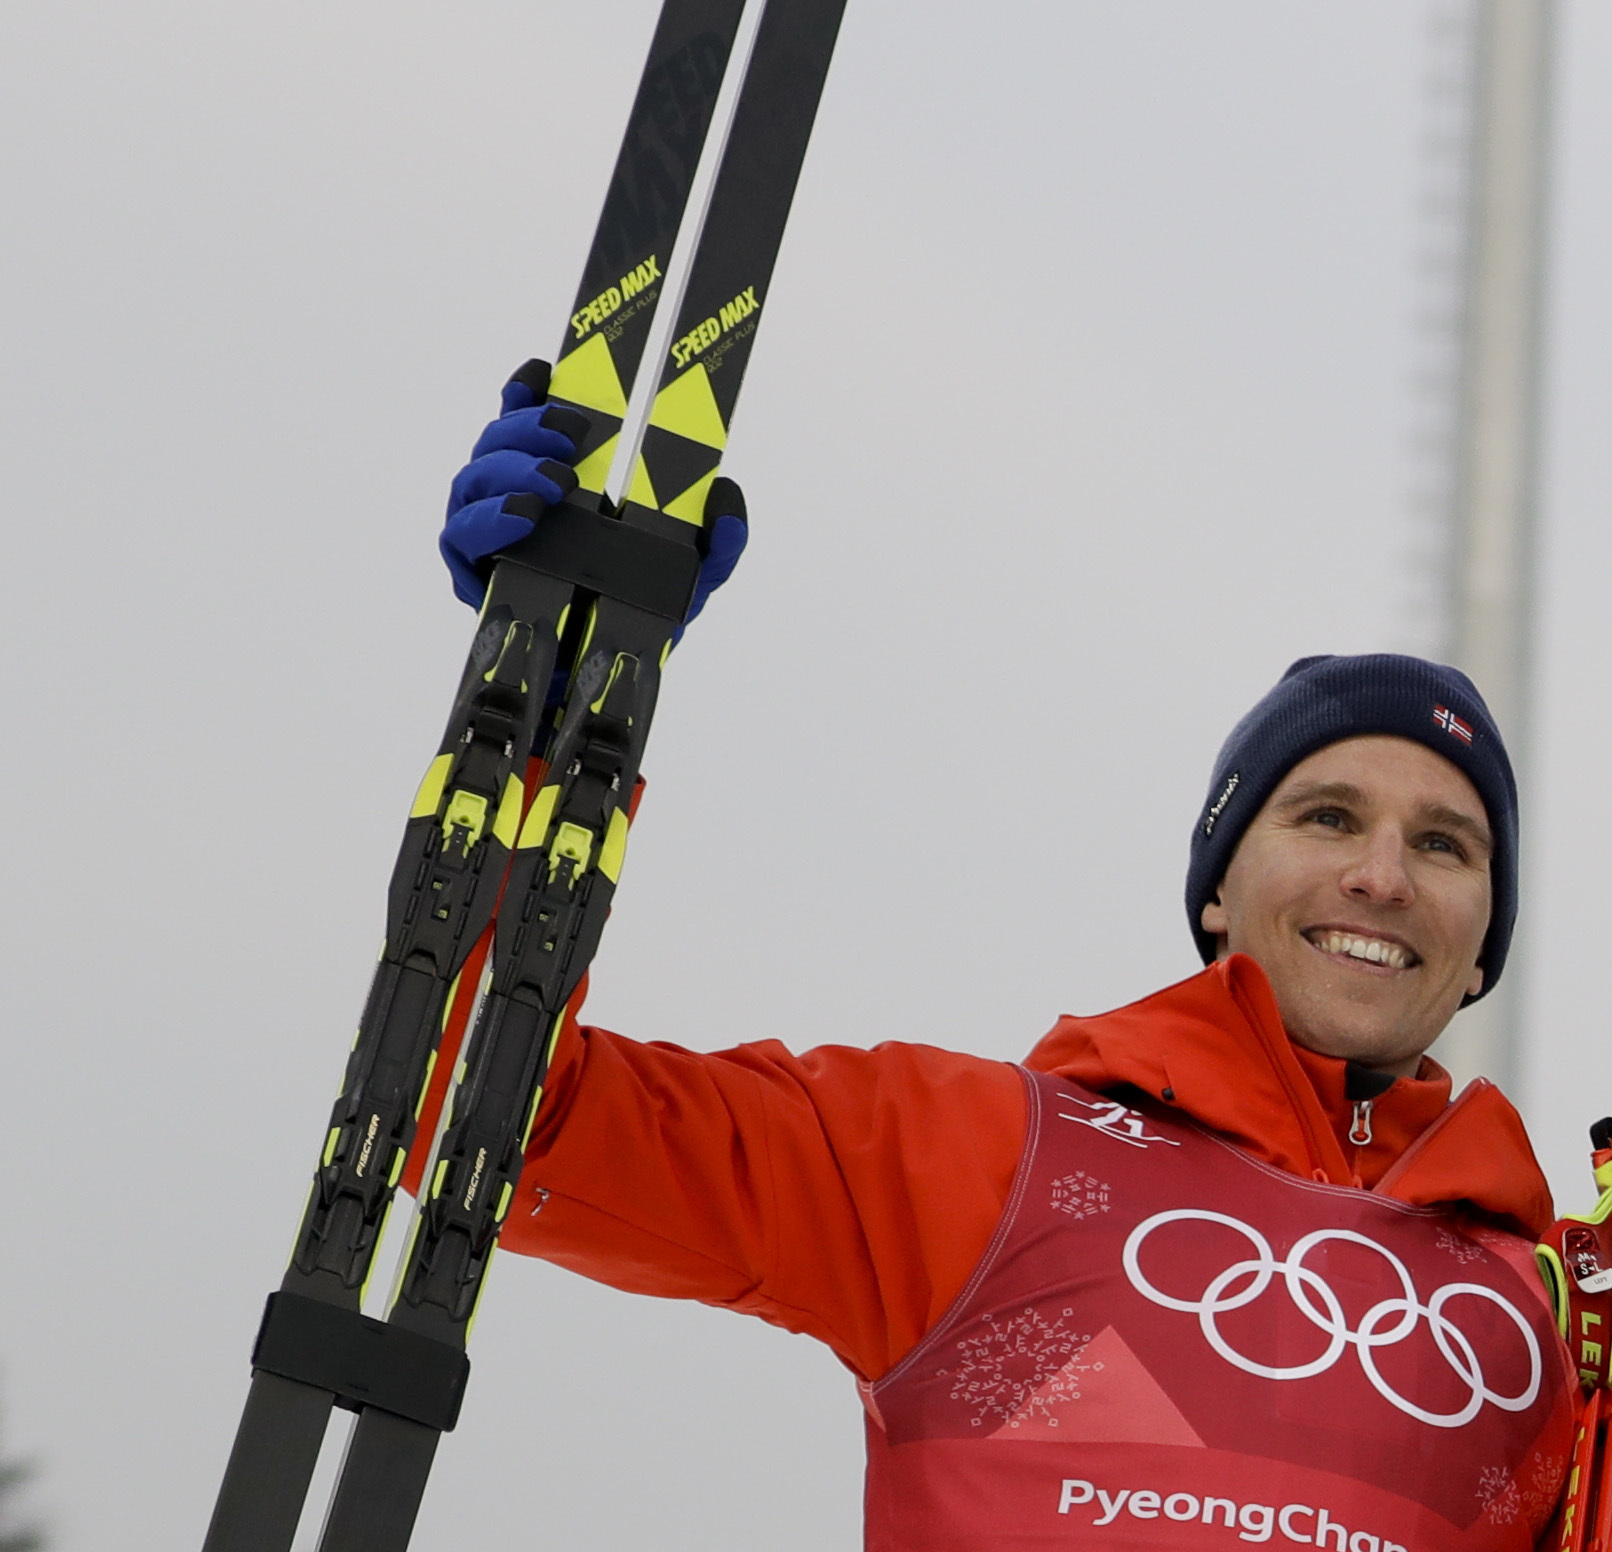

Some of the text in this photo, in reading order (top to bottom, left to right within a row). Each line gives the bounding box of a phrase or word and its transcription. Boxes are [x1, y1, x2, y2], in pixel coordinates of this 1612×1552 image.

[571, 254, 662, 339] SPEED MAX
[671, 286, 760, 370] SPEED MAX
[355, 1113, 381, 1179] FISCHER
[462, 1146, 488, 1212] FISCHER
[1580, 1311, 1602, 1387] LEK
